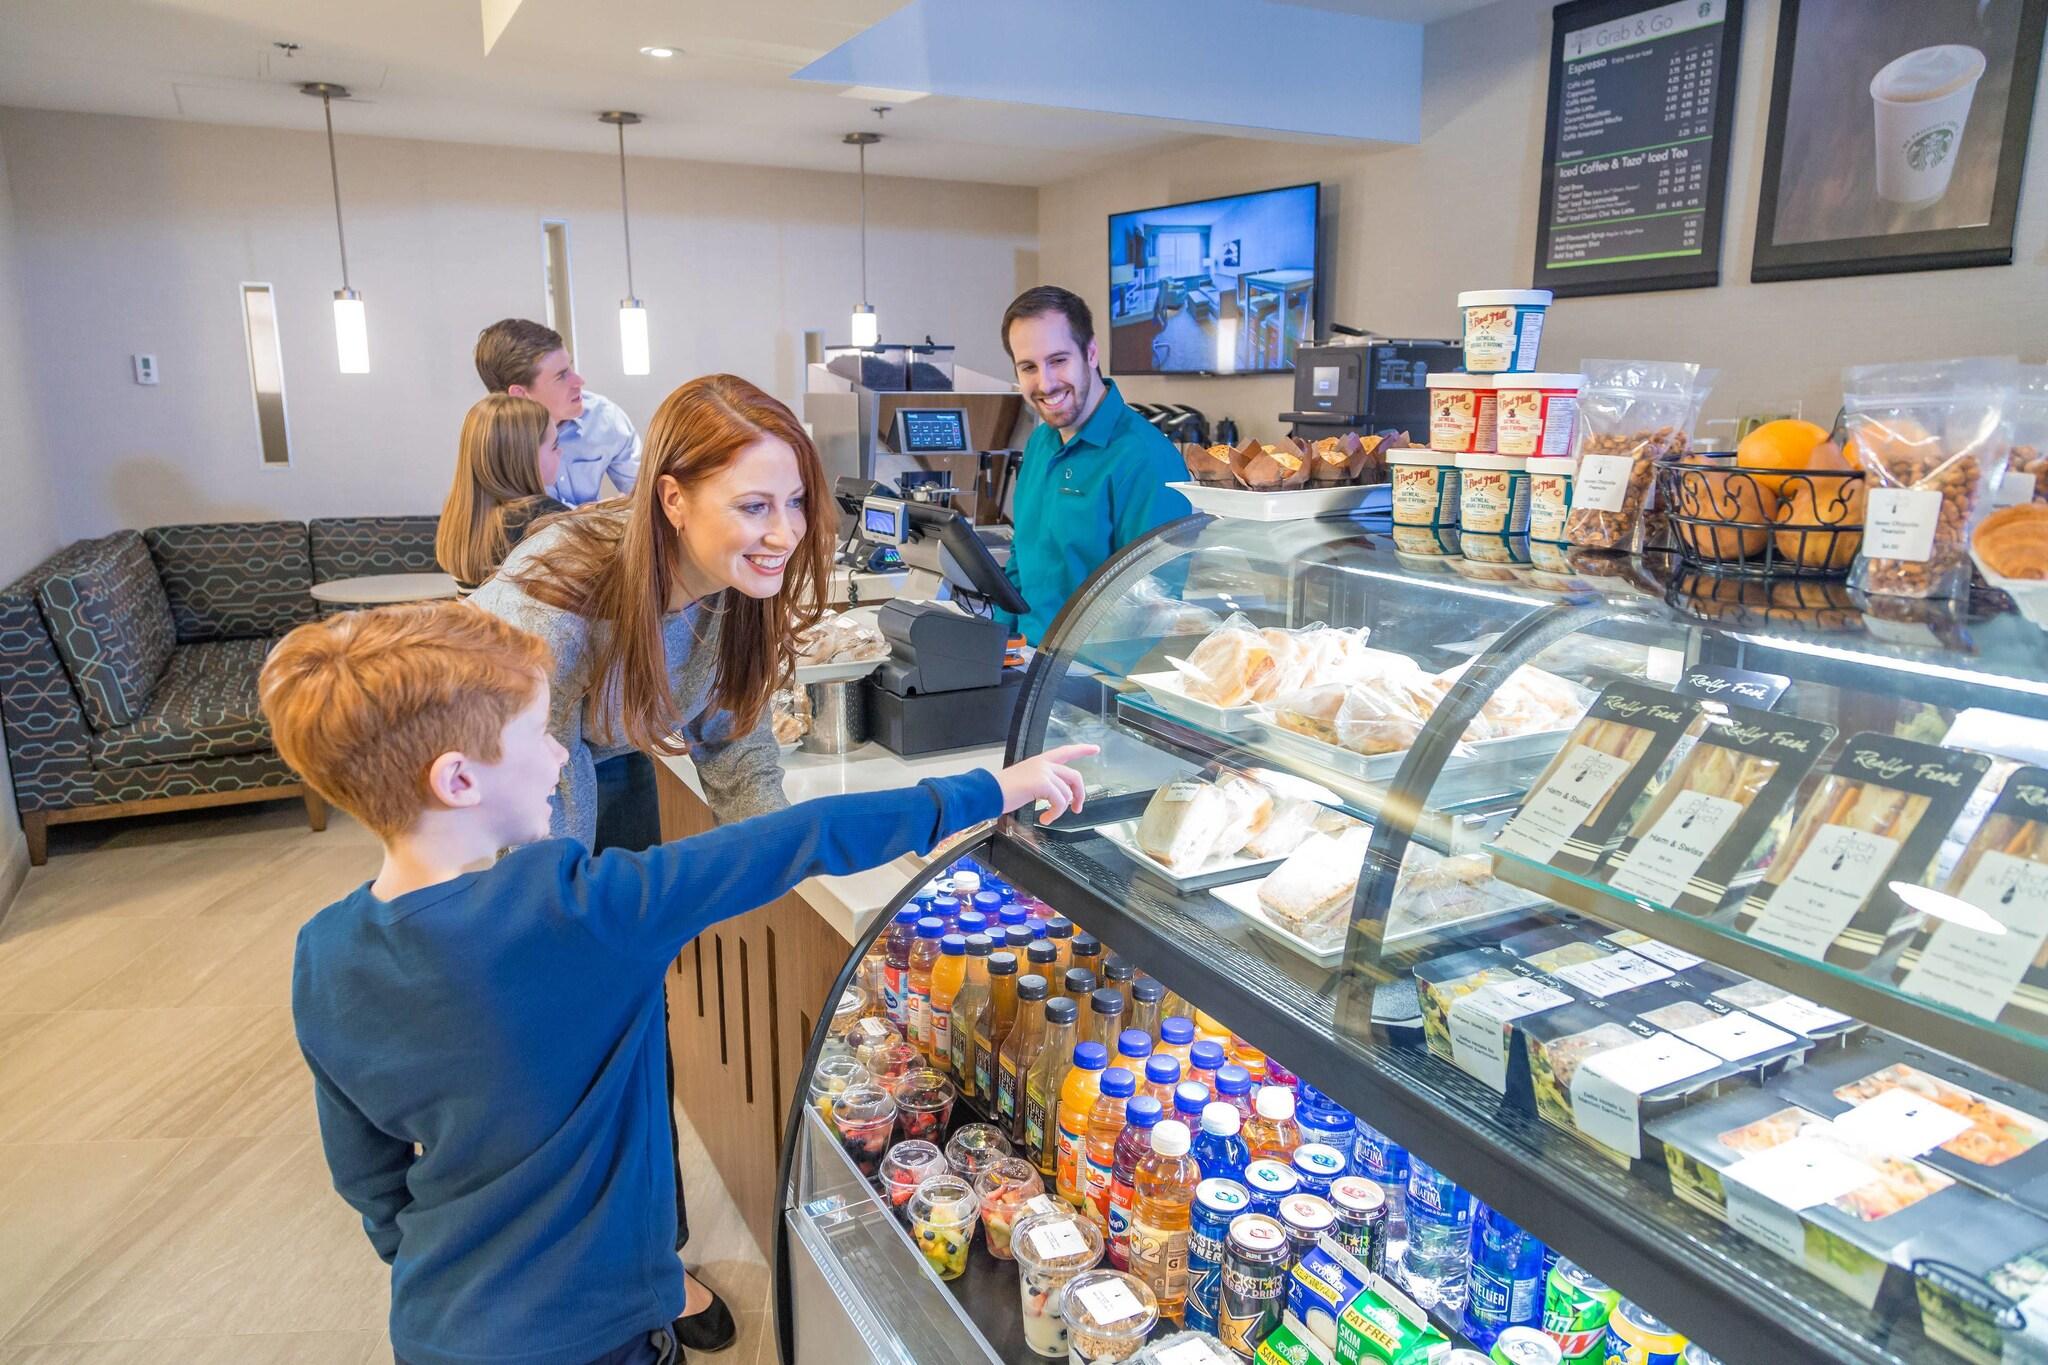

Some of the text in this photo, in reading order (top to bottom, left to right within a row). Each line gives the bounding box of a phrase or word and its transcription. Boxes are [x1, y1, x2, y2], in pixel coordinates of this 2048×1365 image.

[1596, 24, 1630, 46] Grab
[1634, 19, 1646, 37] &
[1651, 14, 1673, 32] Go
[1568, 58, 1608, 75] Espresso
[1560, 164, 1578, 177] Iced
[1580, 160, 1610, 175] Coffee
[1611, 158, 1619, 170] &
[1648, 149, 1669, 163] Iced
[1671, 147, 1689, 159] Tea
[1474, 310, 1507, 327] Red Mill
[1400, 470, 1430, 483] Red Mill
[1469, 475, 1501, 488] Red Mill
[1540, 480, 1556, 492] Mill
[1689, 674, 1770, 700] Really Fresh
[1604, 695, 1682, 724] Really Fresh
[1720, 720, 1811, 752] Really Fresh
[1853, 750, 1965, 787] Really Fresh
[1546, 786, 1562, 797] Ham
[1562, 792, 1569, 800] &
[1569, 795, 1592, 810] Swiss
[1650, 834, 1704, 858] Ham & Swiss
[1355, 1139, 1384, 1168] UAFINA
[1168, 1258, 1179, 1268] G
[1339, 1323, 1360, 1350] SKIM
[1346, 1310, 1365, 1327] FAT
[1365, 1323, 1393, 1348] FREE
[1260, 1346, 1282, 1365] SANS
[1338, 1342, 1358, 1363] Milk
